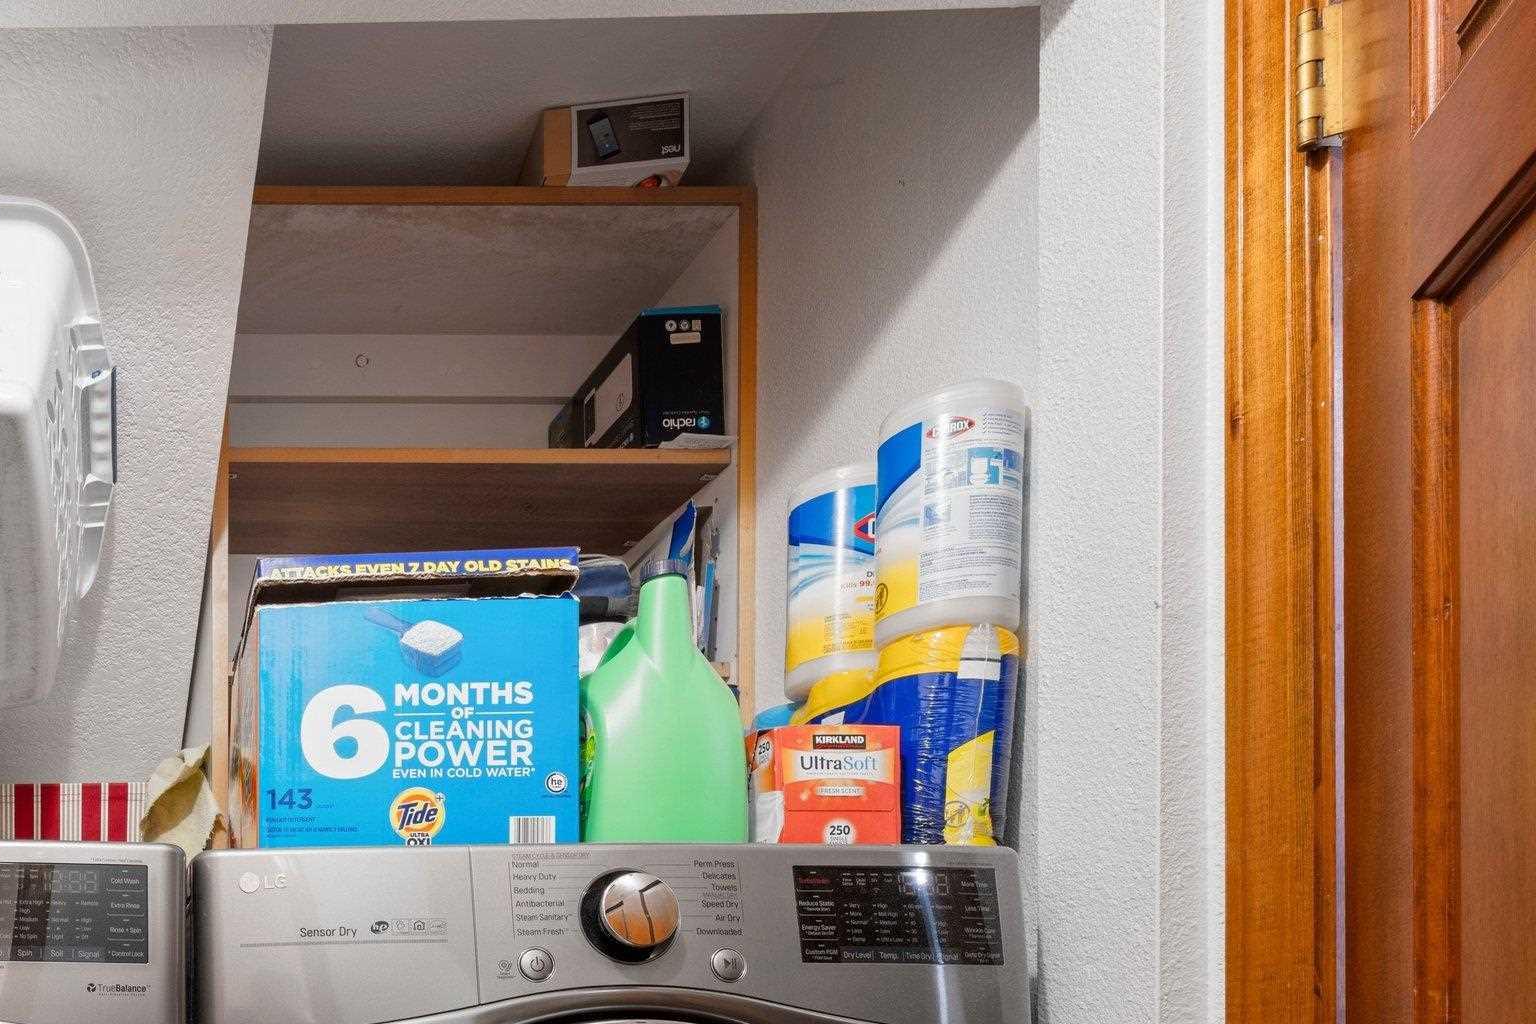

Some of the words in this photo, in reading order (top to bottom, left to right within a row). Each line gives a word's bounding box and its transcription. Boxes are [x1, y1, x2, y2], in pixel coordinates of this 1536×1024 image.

[661, 144, 681, 155] nest
[662, 417, 696, 430] rachio
[270, 565, 352, 580] ATTACKS
[355, 562, 405, 575] EVEN
[408, 561, 421, 574] 7
[424, 560, 461, 573] DAY
[465, 559, 502, 573] OLD
[505, 558, 571, 571] STAINS
[394, 681, 534, 707] MONTHS
[450, 706, 475, 719] OF
[300, 684, 390, 779] 6
[394, 719, 534, 740] CLEANING
[815, 736, 865, 744] KIRKLAND
[394, 739, 534, 767] POWER
[758, 741, 770, 755] 250
[800, 755, 878, 770] UltraSoft
[392, 768, 427, 779] EVEN
[430, 768, 443, 778] IN
[447, 767, 482, 778] COLD
[550, 777, 563, 787] he
[267, 788, 313, 810] 143
[397, 802, 438, 831] Tide
[829, 825, 851, 836] 250
[407, 837, 432, 846] OXI
[693, 860, 712, 868] Perm
[714, 860, 735, 868] Press
[512, 873, 537, 881] Heavy
[513, 887, 545, 895] Bedding
[711, 883, 738, 891] Towels
[701, 900, 725, 908] Speed
[725, 900, 739, 908] Dry
[727, 913, 741, 922] Dry
[299, 927, 336, 938] Sensor
[339, 926, 357, 938] Dry
[517, 928, 541, 936] Steam
[696, 927, 743, 935] Downloaded
[17, 948, 33, 958] Spin
[50, 949, 64, 957] Soil
[843, 951, 854, 959] Dry
[855, 951, 872, 959] Level
[98, 983, 147, 993] TrueBalance
